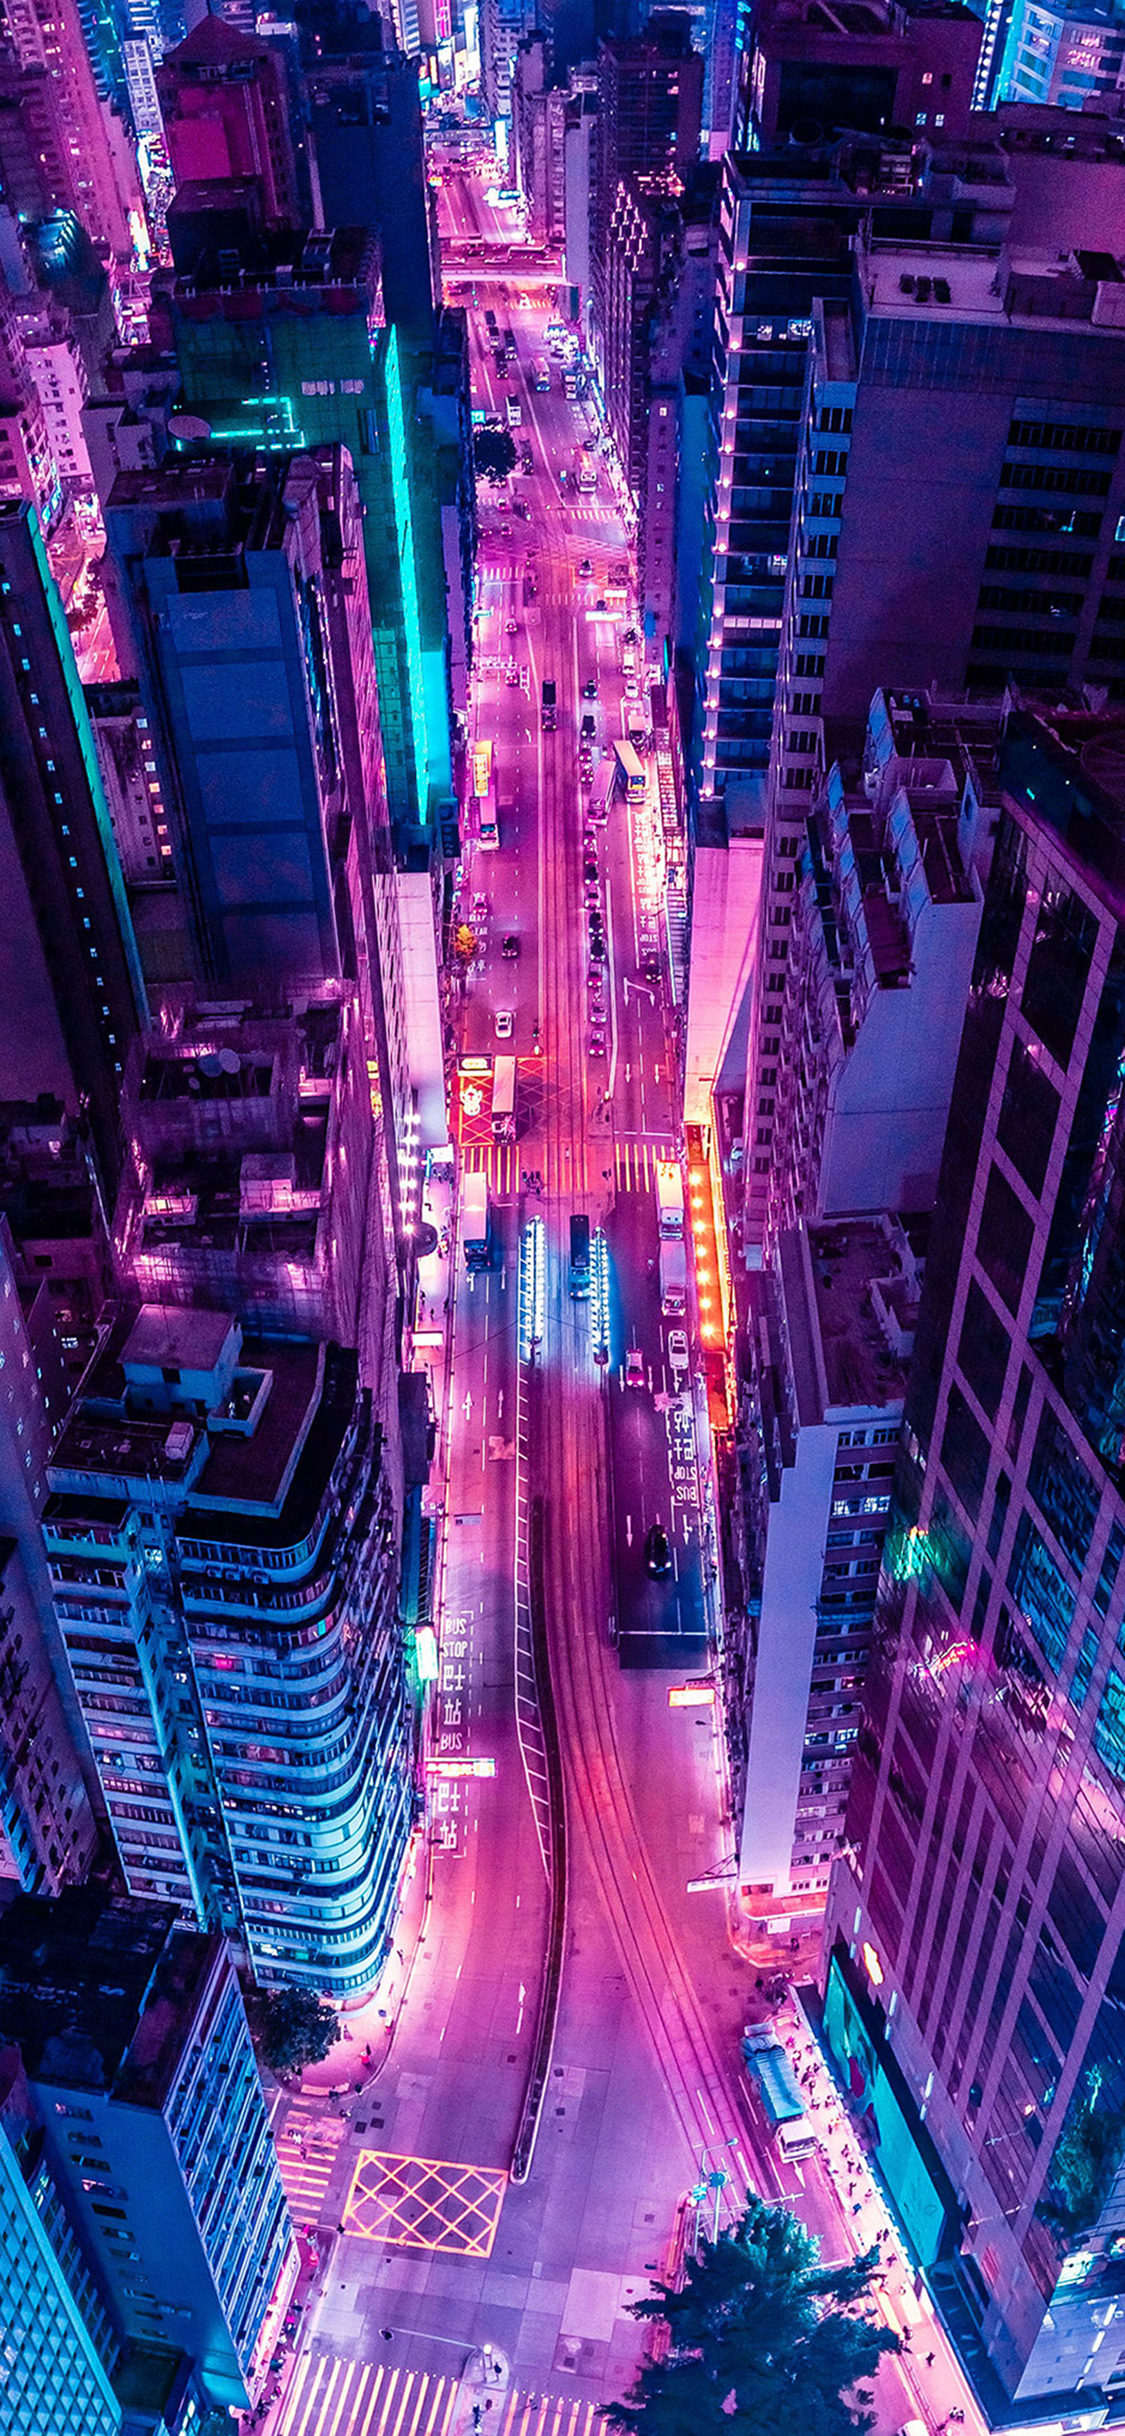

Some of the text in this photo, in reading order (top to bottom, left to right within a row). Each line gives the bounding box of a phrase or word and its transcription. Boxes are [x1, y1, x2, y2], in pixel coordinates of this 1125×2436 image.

[639, 933, 658, 943] STOP
[673, 1438, 694, 1461] 巴士
[673, 1466, 697, 1480] STOP
[676, 1486, 697, 1501] BUS
[445, 1618, 467, 1635] BUS
[442, 1641, 468, 1658] STOP
[443, 1664, 466, 1691] 巴士
[443, 1697, 462, 1725] 站
[440, 1733, 463, 1750] BUS
[437, 1782, 461, 1812] 巴士
